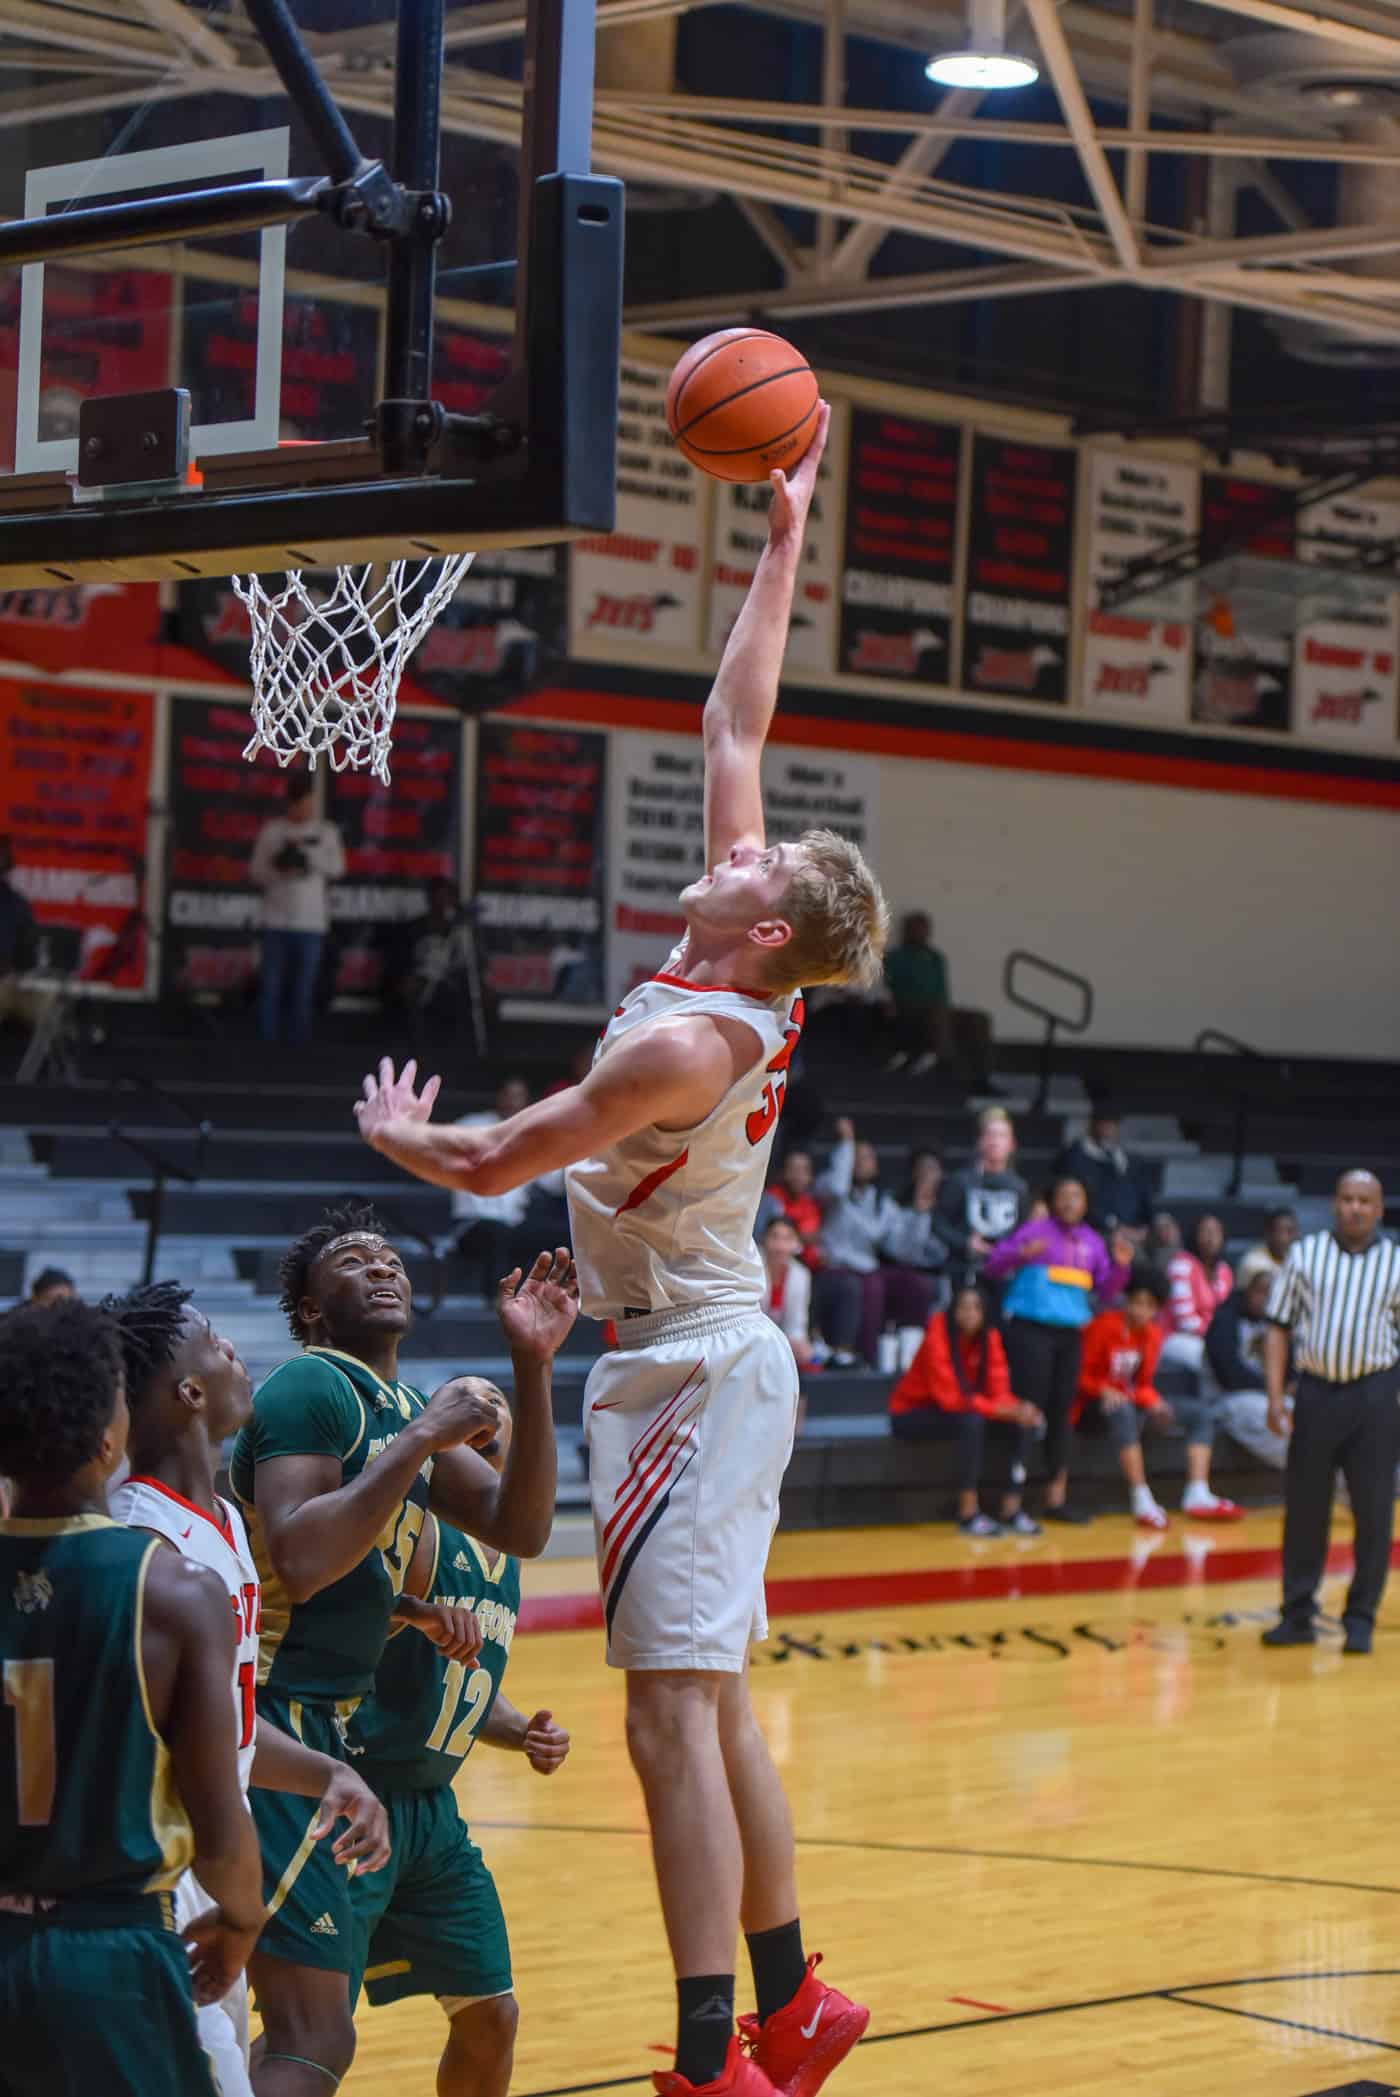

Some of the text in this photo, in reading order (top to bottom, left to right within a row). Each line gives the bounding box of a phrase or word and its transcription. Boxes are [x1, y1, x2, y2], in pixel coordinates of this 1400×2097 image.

[585, 594, 657, 634] JETS
[2, 1657, 55, 1827] 1
[425, 1659, 493, 1758] 12
